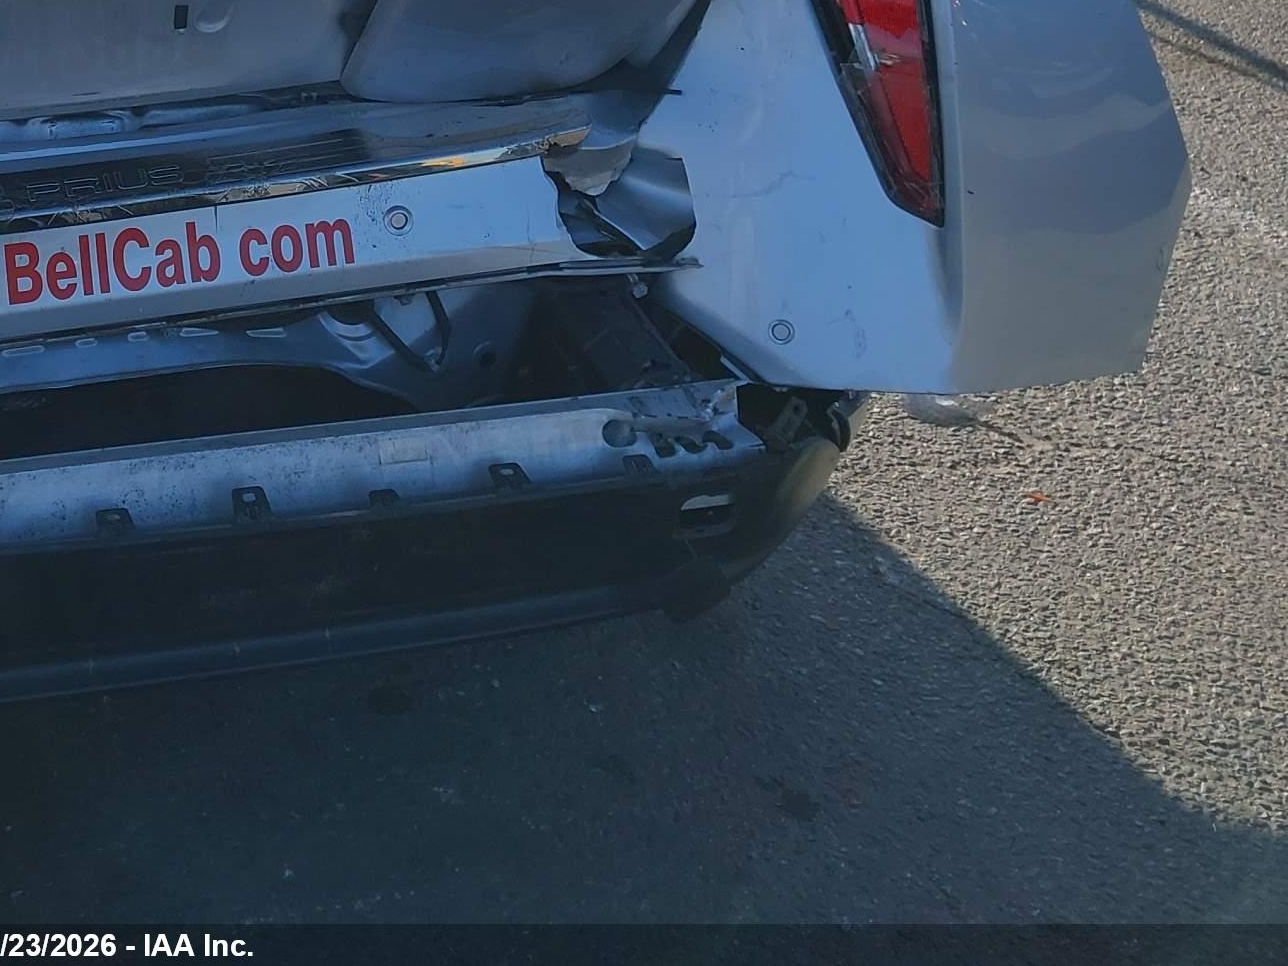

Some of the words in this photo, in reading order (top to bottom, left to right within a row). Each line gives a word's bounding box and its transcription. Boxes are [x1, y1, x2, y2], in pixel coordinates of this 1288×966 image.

[27, 165, 186, 203] PRIUS
[4, 221, 222, 305] BellCab
[239, 217, 355, 277] com
